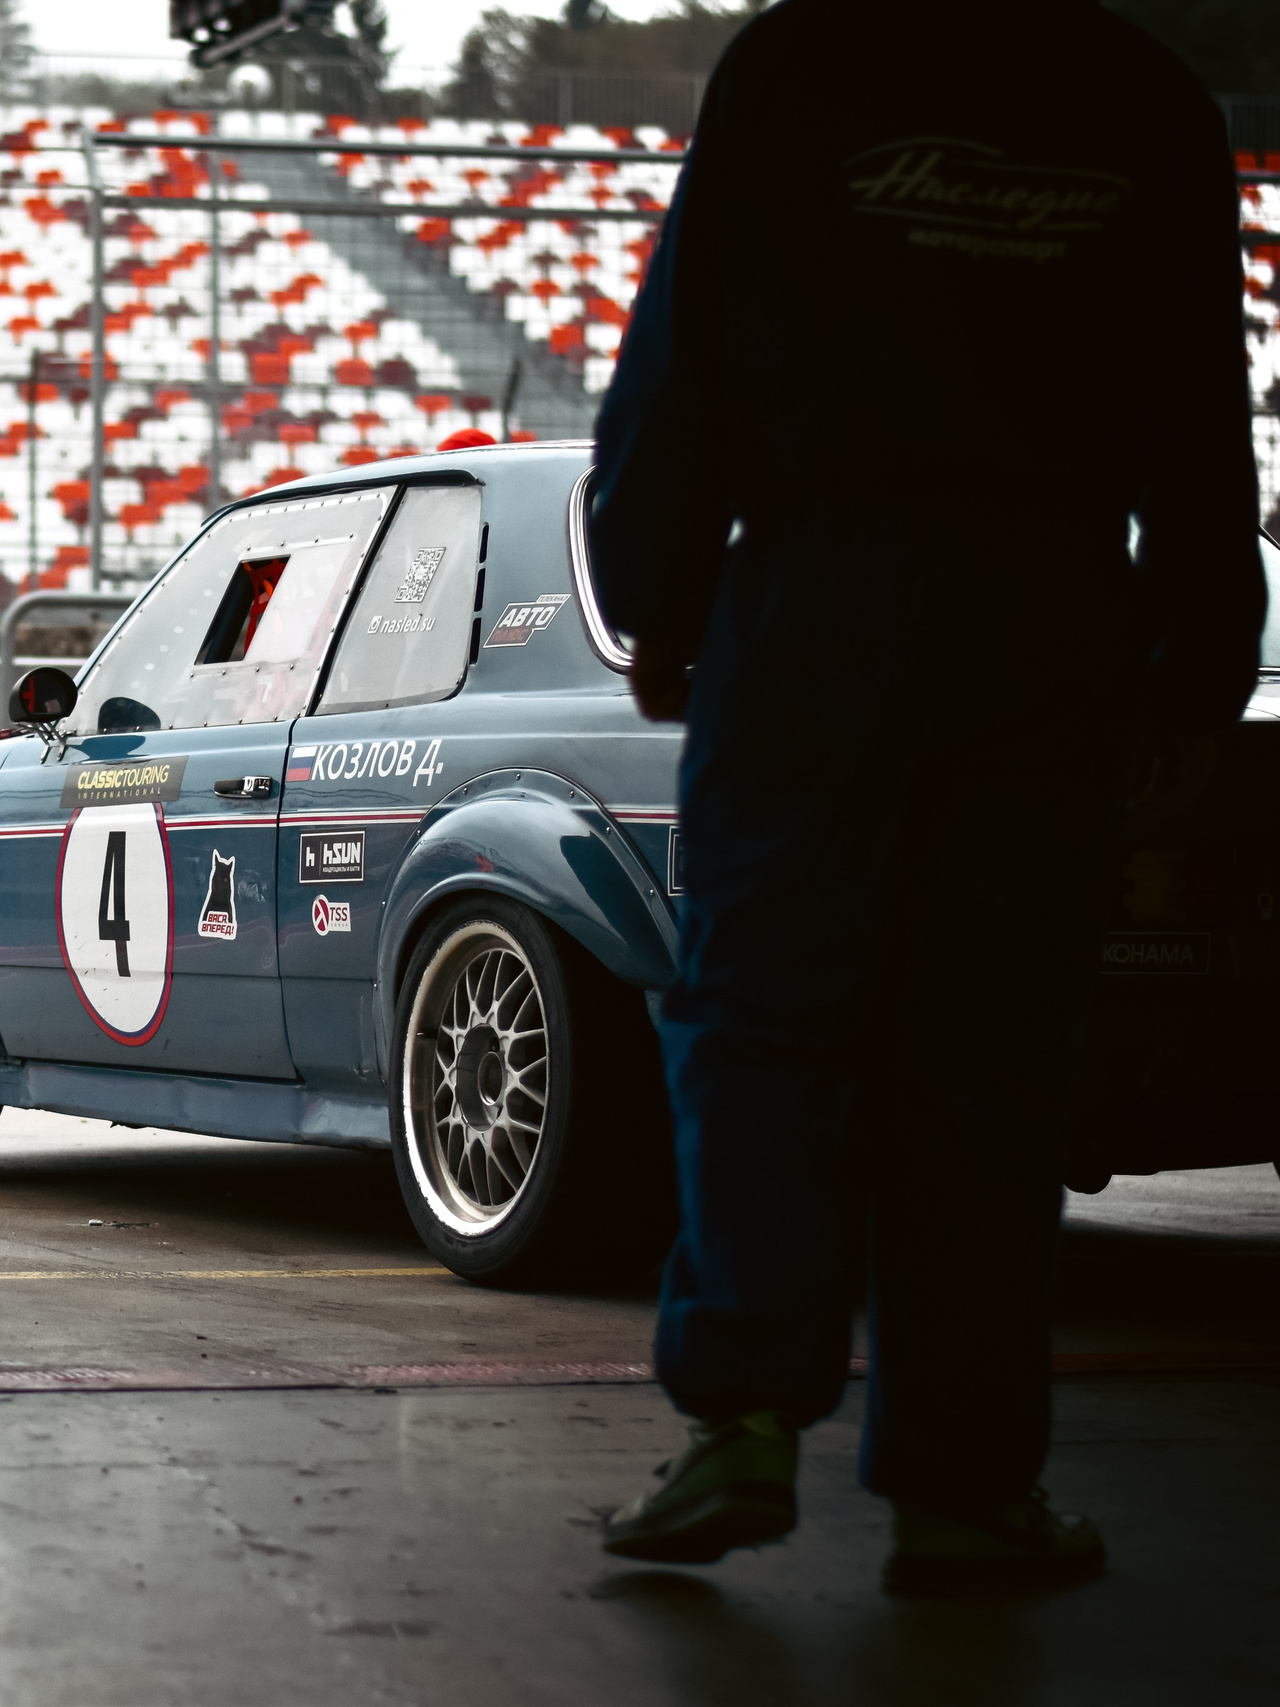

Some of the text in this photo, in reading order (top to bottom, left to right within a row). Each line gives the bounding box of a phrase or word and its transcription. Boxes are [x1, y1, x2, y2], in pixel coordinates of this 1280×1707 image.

[380, 615, 436, 633] nasled.su
[498, 606, 556, 628] АВТО
[311, 738, 444, 787] КОЗЛОВ Д.
[78, 787, 161, 800] INTERNATIONAL
[98, 830, 131, 978] 4
[208, 913, 228, 924] ВАСЯ
[329, 907, 348, 922] TSS
[1102, 943, 1195, 964] KOHAMA
